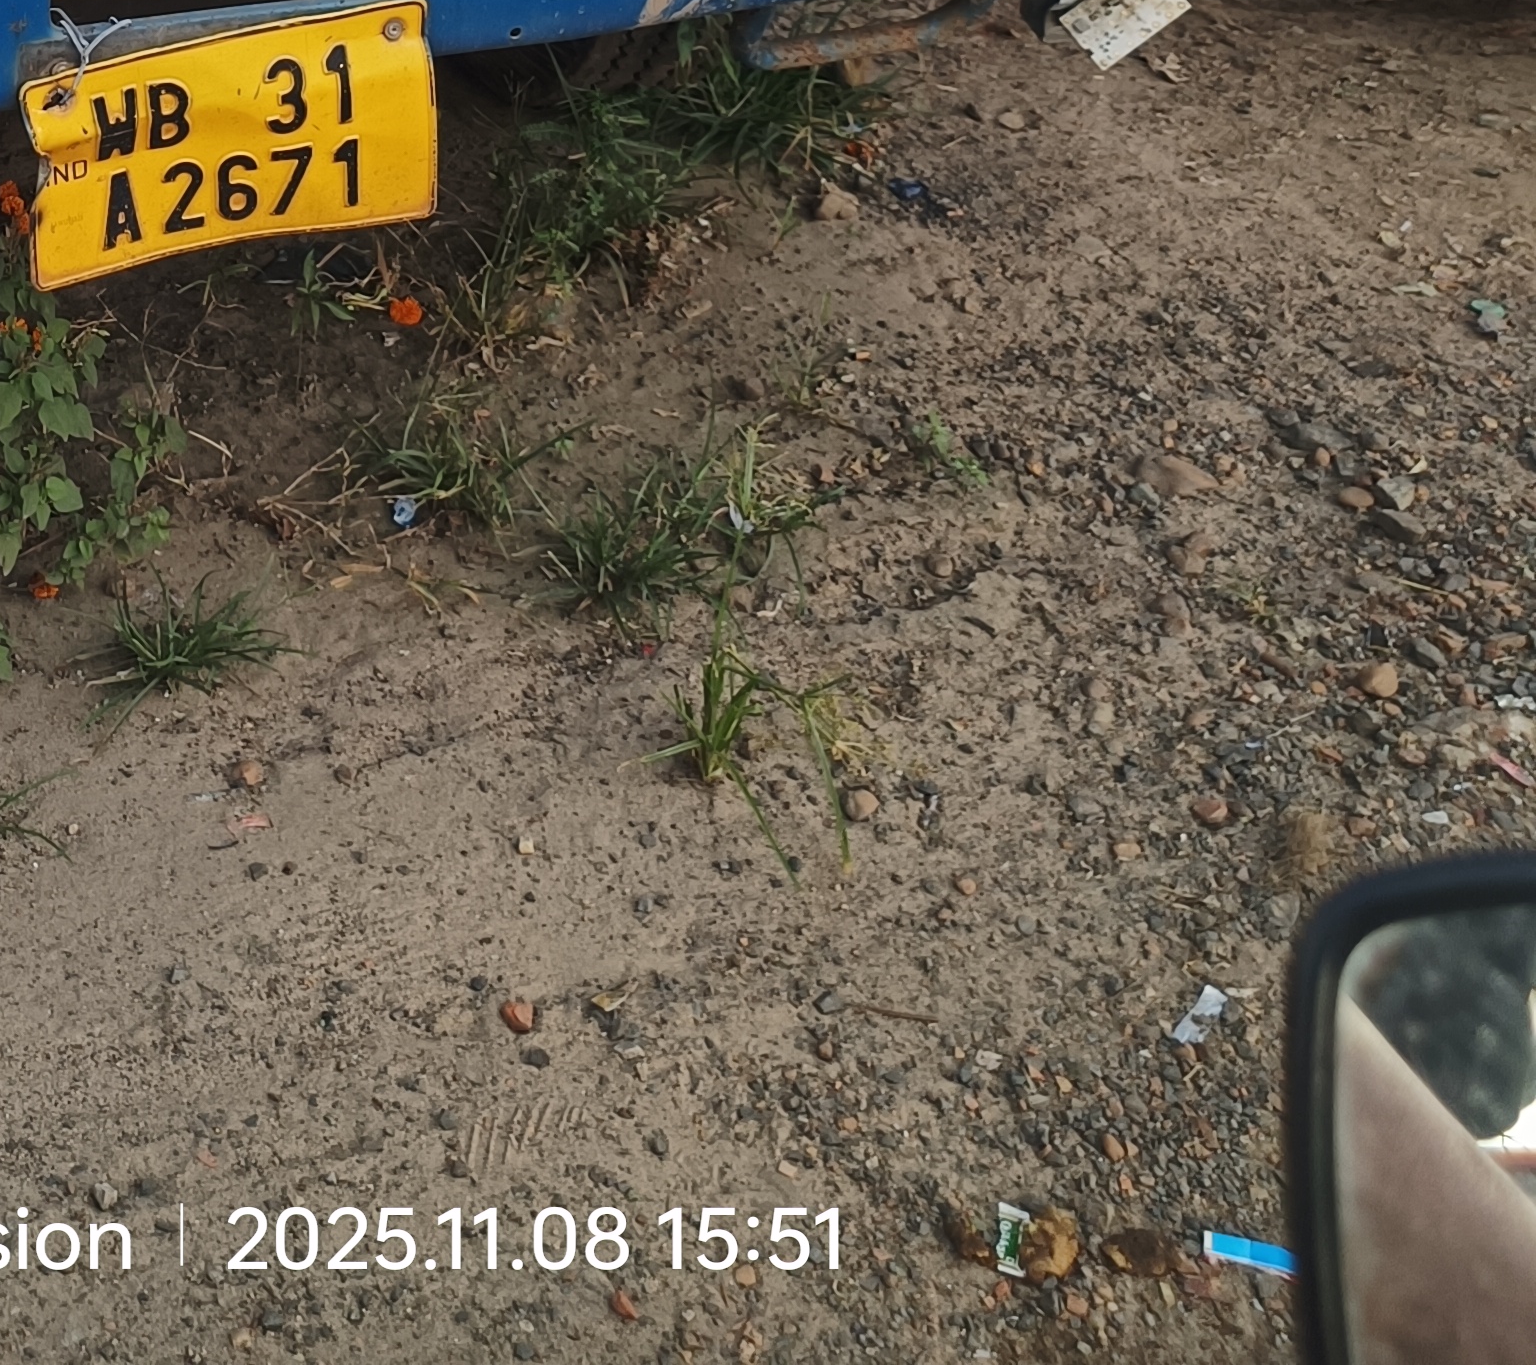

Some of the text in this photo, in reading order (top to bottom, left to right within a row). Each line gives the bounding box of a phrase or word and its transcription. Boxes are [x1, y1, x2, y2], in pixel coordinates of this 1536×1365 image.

[93, 43, 354, 162] WB 31
[46, 159, 88, 187] ND
[102, 137, 361, 251] A2671
